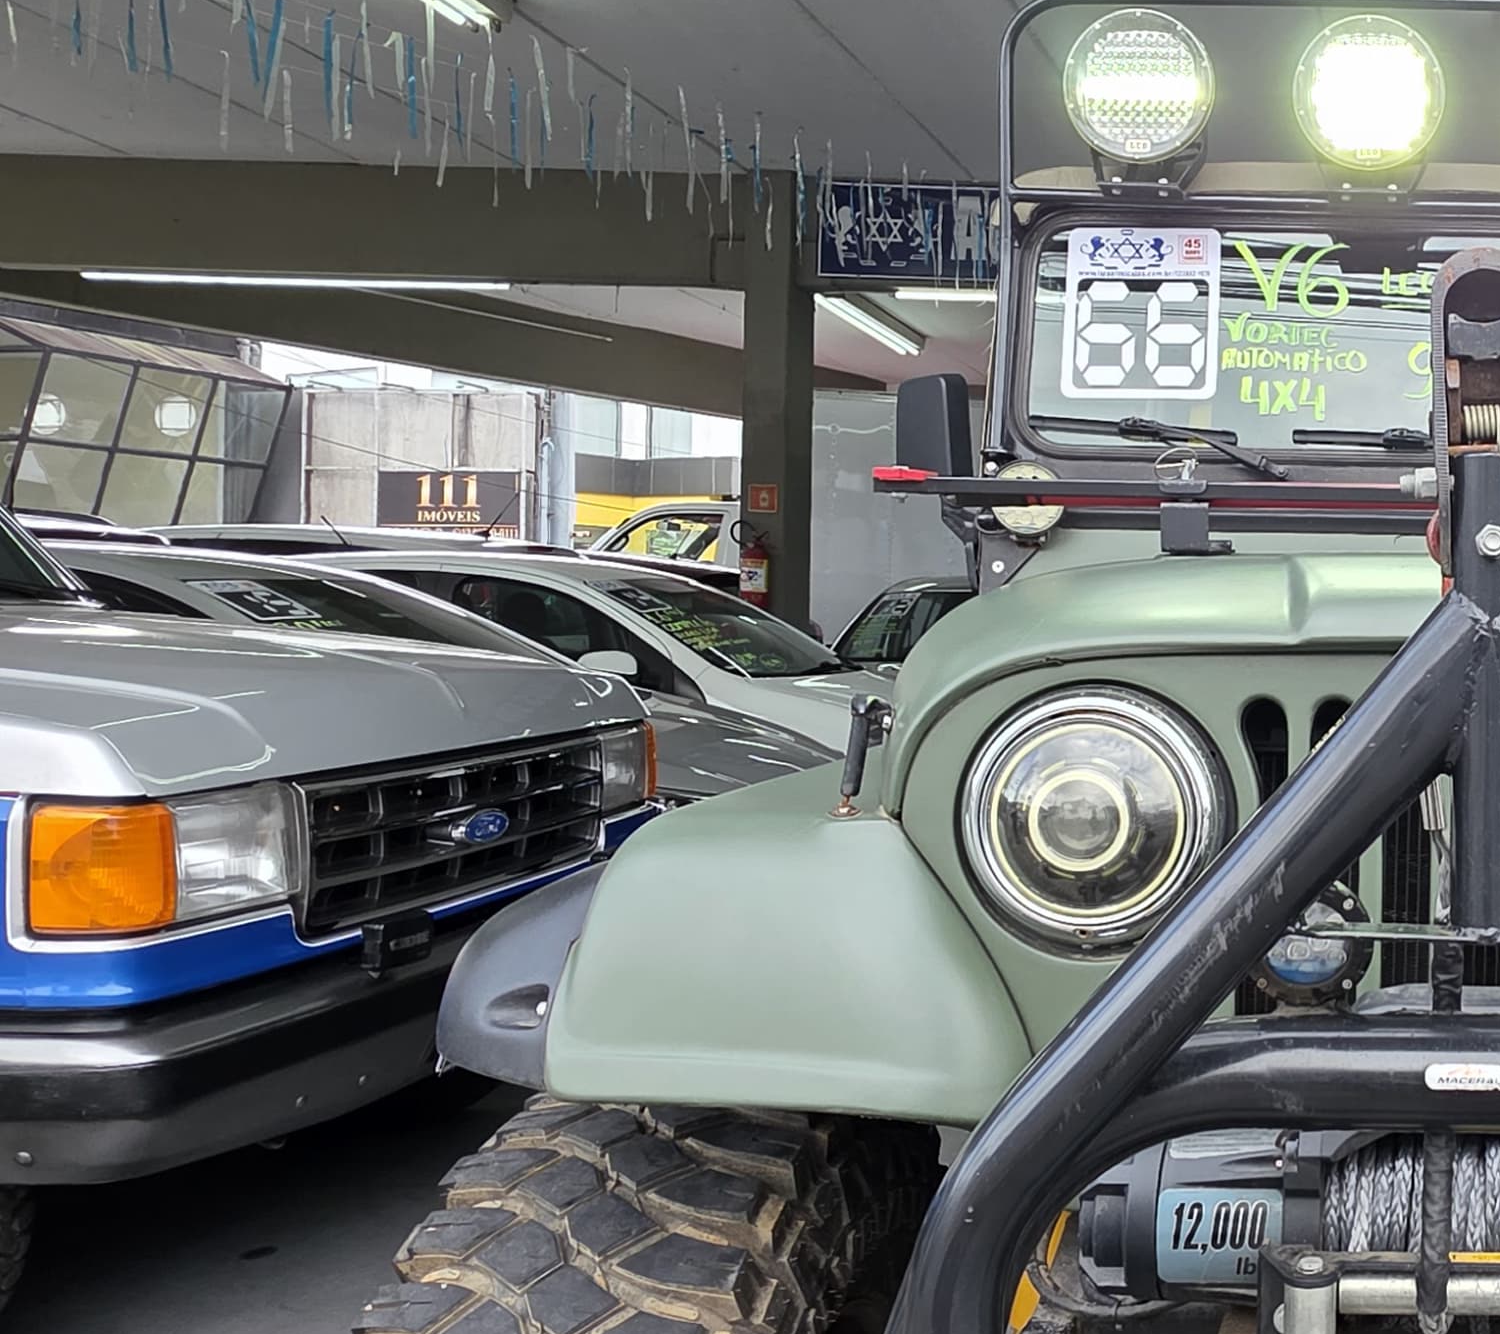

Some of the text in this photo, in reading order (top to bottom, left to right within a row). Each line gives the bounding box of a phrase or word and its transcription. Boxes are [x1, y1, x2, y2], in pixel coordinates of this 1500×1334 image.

[1234, 240, 1350, 318] V6
[1075, 281, 1205, 387] 66
[1223, 312, 1339, 348] VORTEC
[1240, 375, 1326, 422] 4X4
[416, 473, 481, 508] 111
[417, 508, 481, 523] IMÓVEIS
[1171, 1200, 1269, 1255] 12,000
